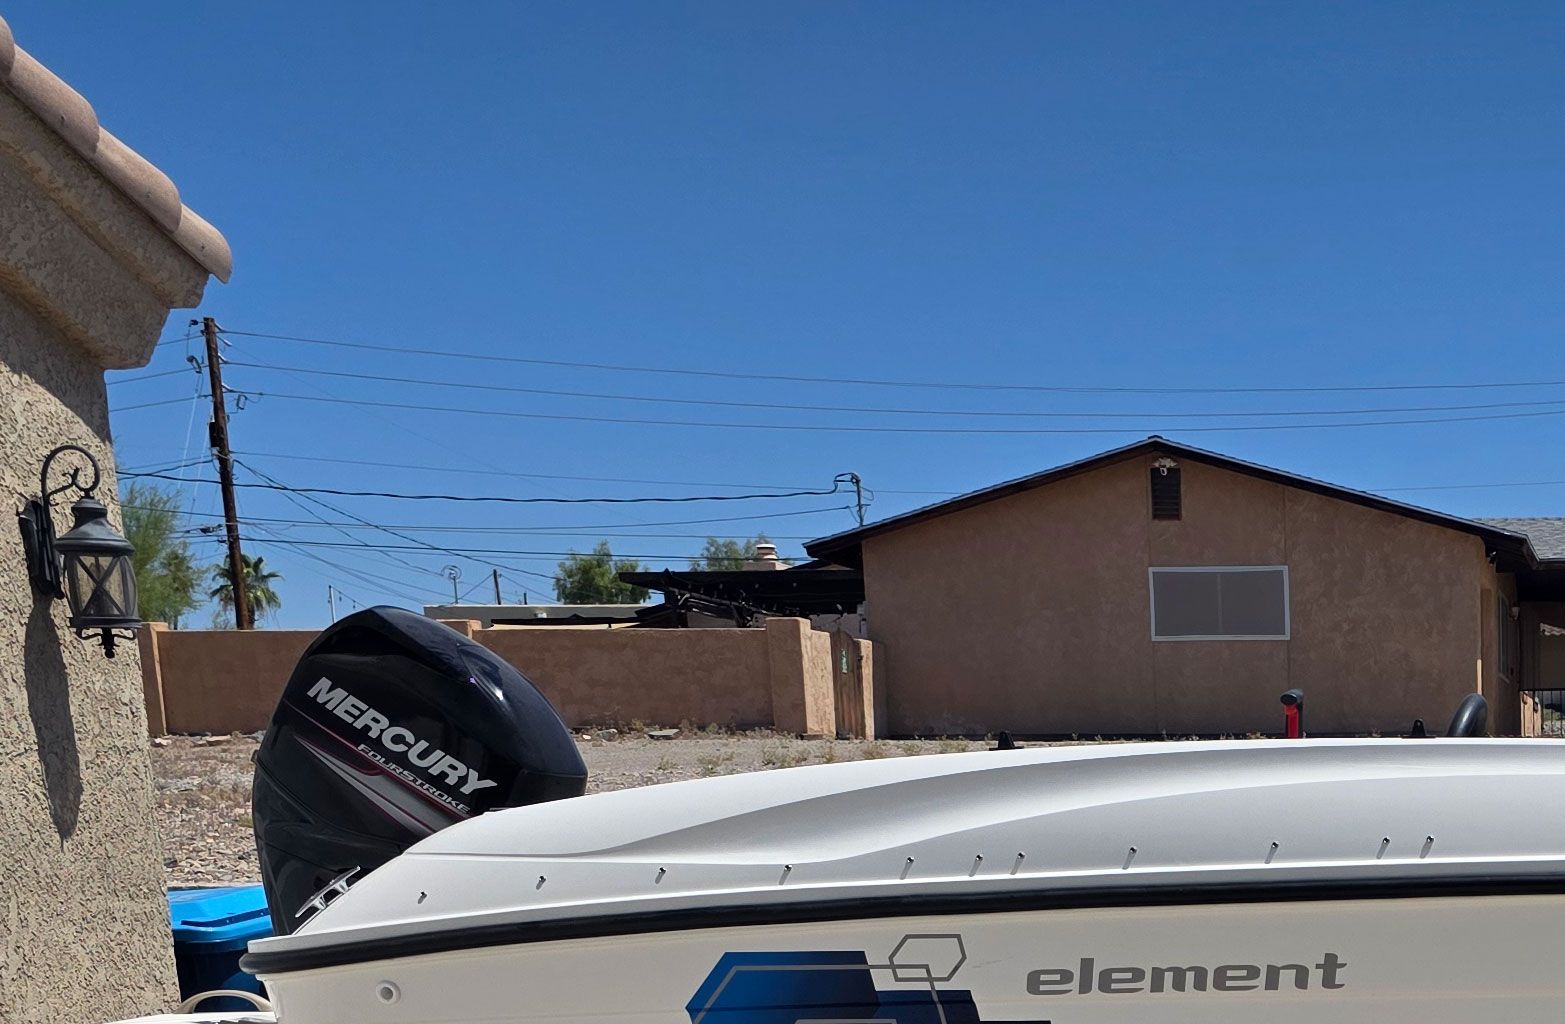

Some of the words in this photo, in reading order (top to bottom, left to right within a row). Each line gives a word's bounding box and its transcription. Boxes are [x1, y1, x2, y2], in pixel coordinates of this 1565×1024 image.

[306, 676, 498, 795] MERCURY
[357, 743, 471, 814] FOURSTROKE
[1026, 952, 1348, 996] element
